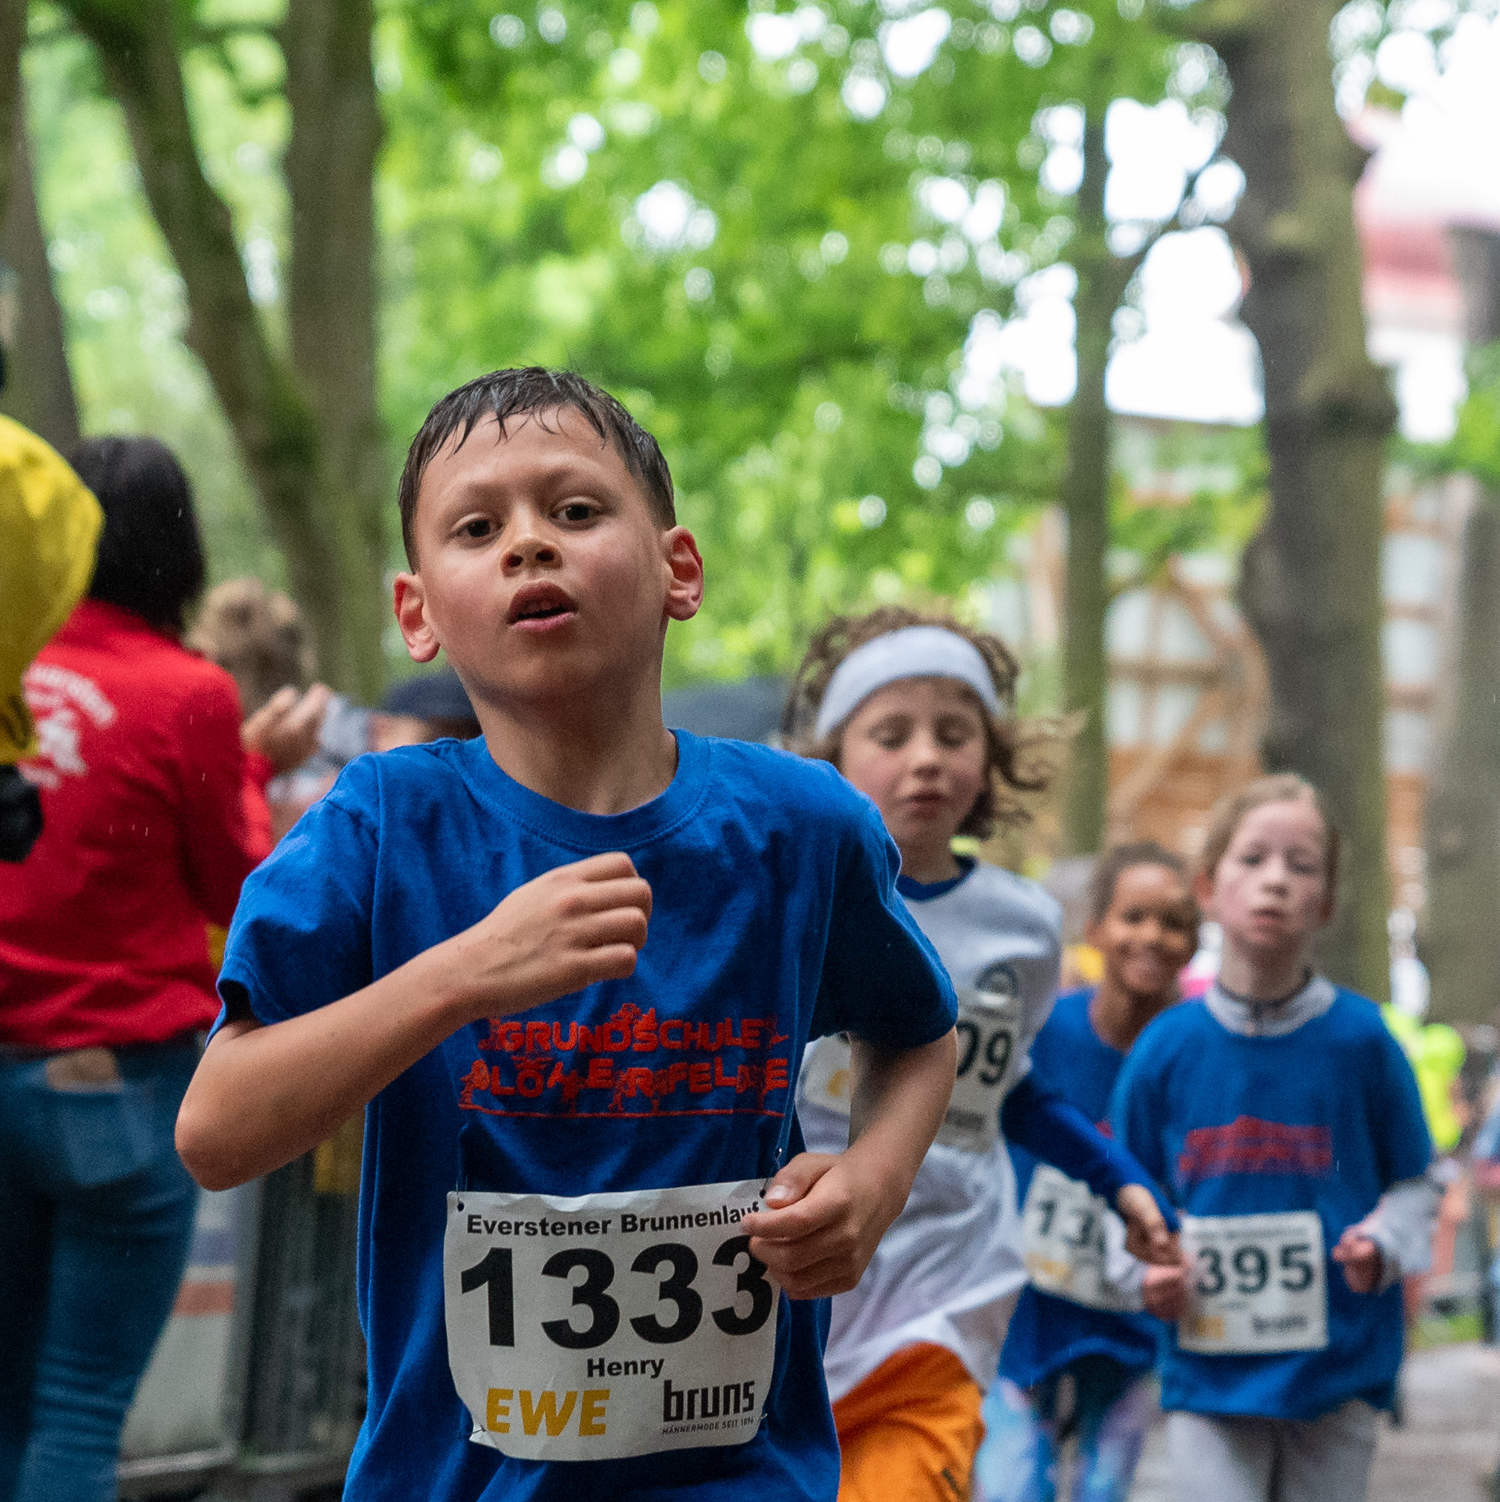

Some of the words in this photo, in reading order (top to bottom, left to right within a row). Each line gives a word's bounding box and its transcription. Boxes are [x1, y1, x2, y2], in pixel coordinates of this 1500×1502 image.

[498, 1017, 766, 1053] GRUNDSCHULE
[466, 1213, 612, 1236] Everstener
[461, 1233, 774, 1350] 1333
[1197, 1243, 1314, 1297] 395
[586, 1358, 665, 1379] Henry
[486, 1387, 611, 1437] EWE
[663, 1379, 755, 1422] bruns
